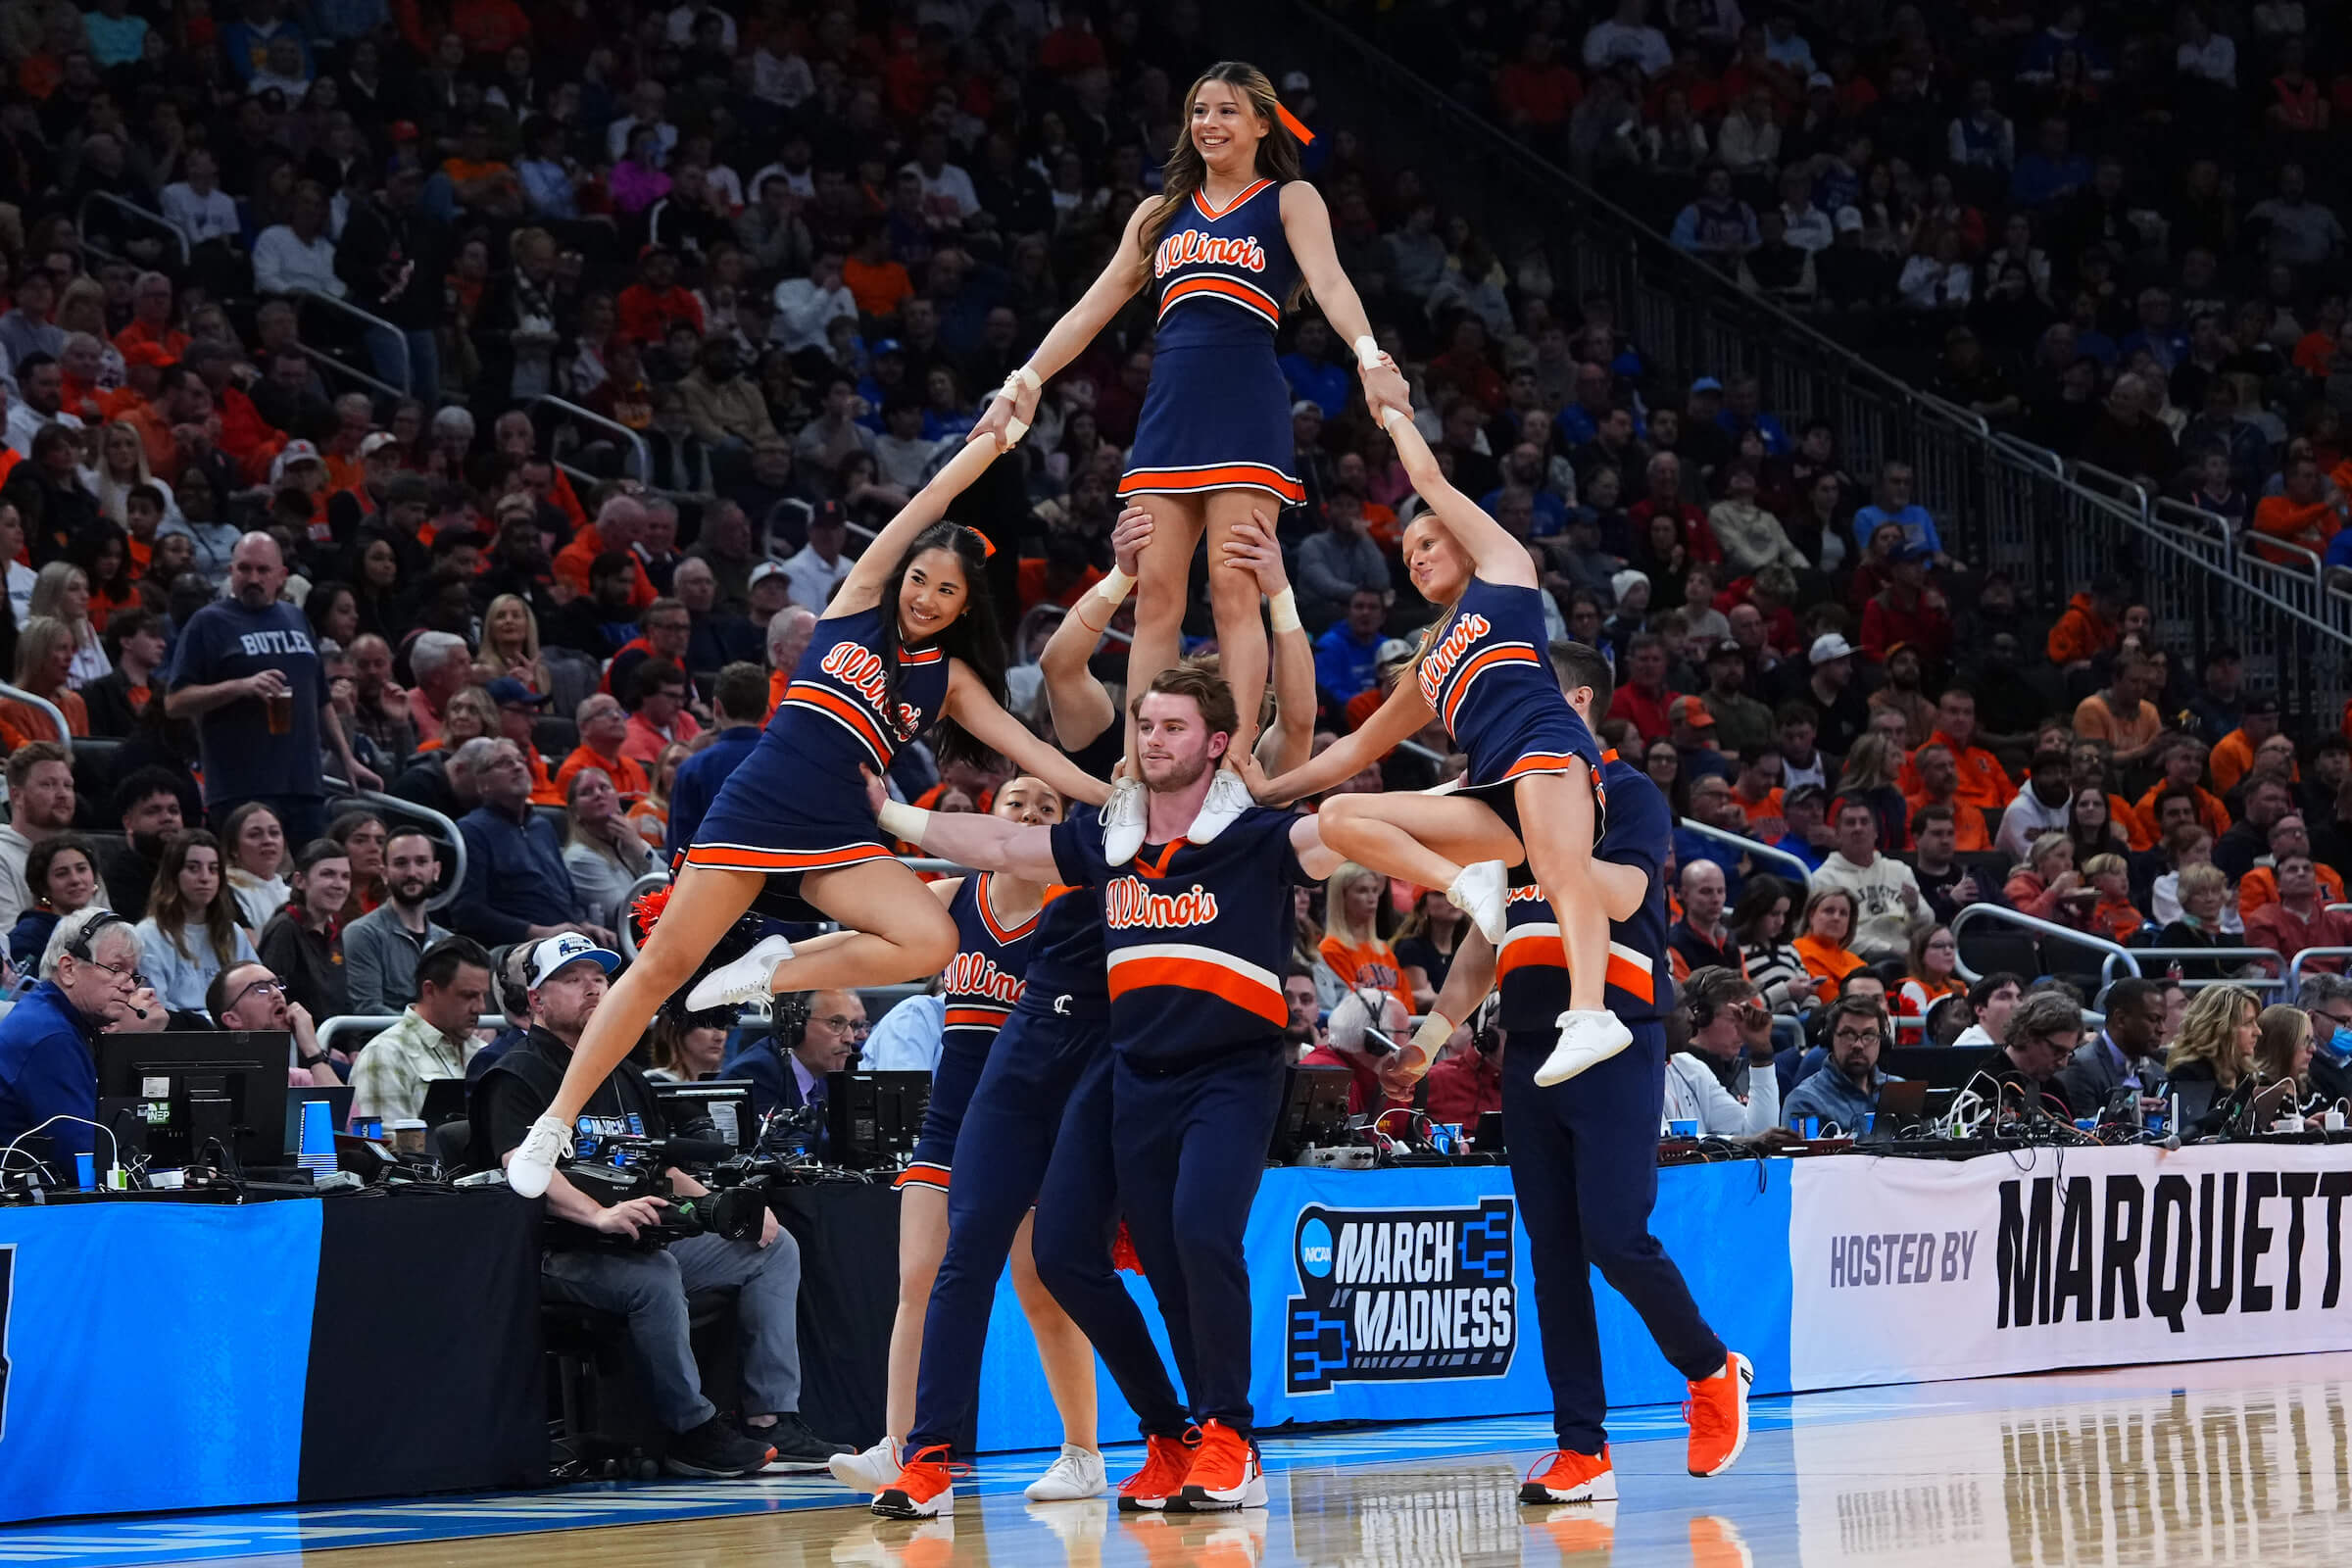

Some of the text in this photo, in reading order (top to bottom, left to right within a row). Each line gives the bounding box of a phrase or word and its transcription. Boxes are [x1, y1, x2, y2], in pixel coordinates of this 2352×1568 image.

[1155, 229, 1266, 279] Illinois
[1418, 612, 1491, 718] llinois
[1105, 875, 1219, 930] Illinois
[1335, 1220, 1455, 1285] MARCH
[1831, 1229, 1979, 1288] HOSTED BY
[1353, 1286, 1512, 1352] MADNESS
